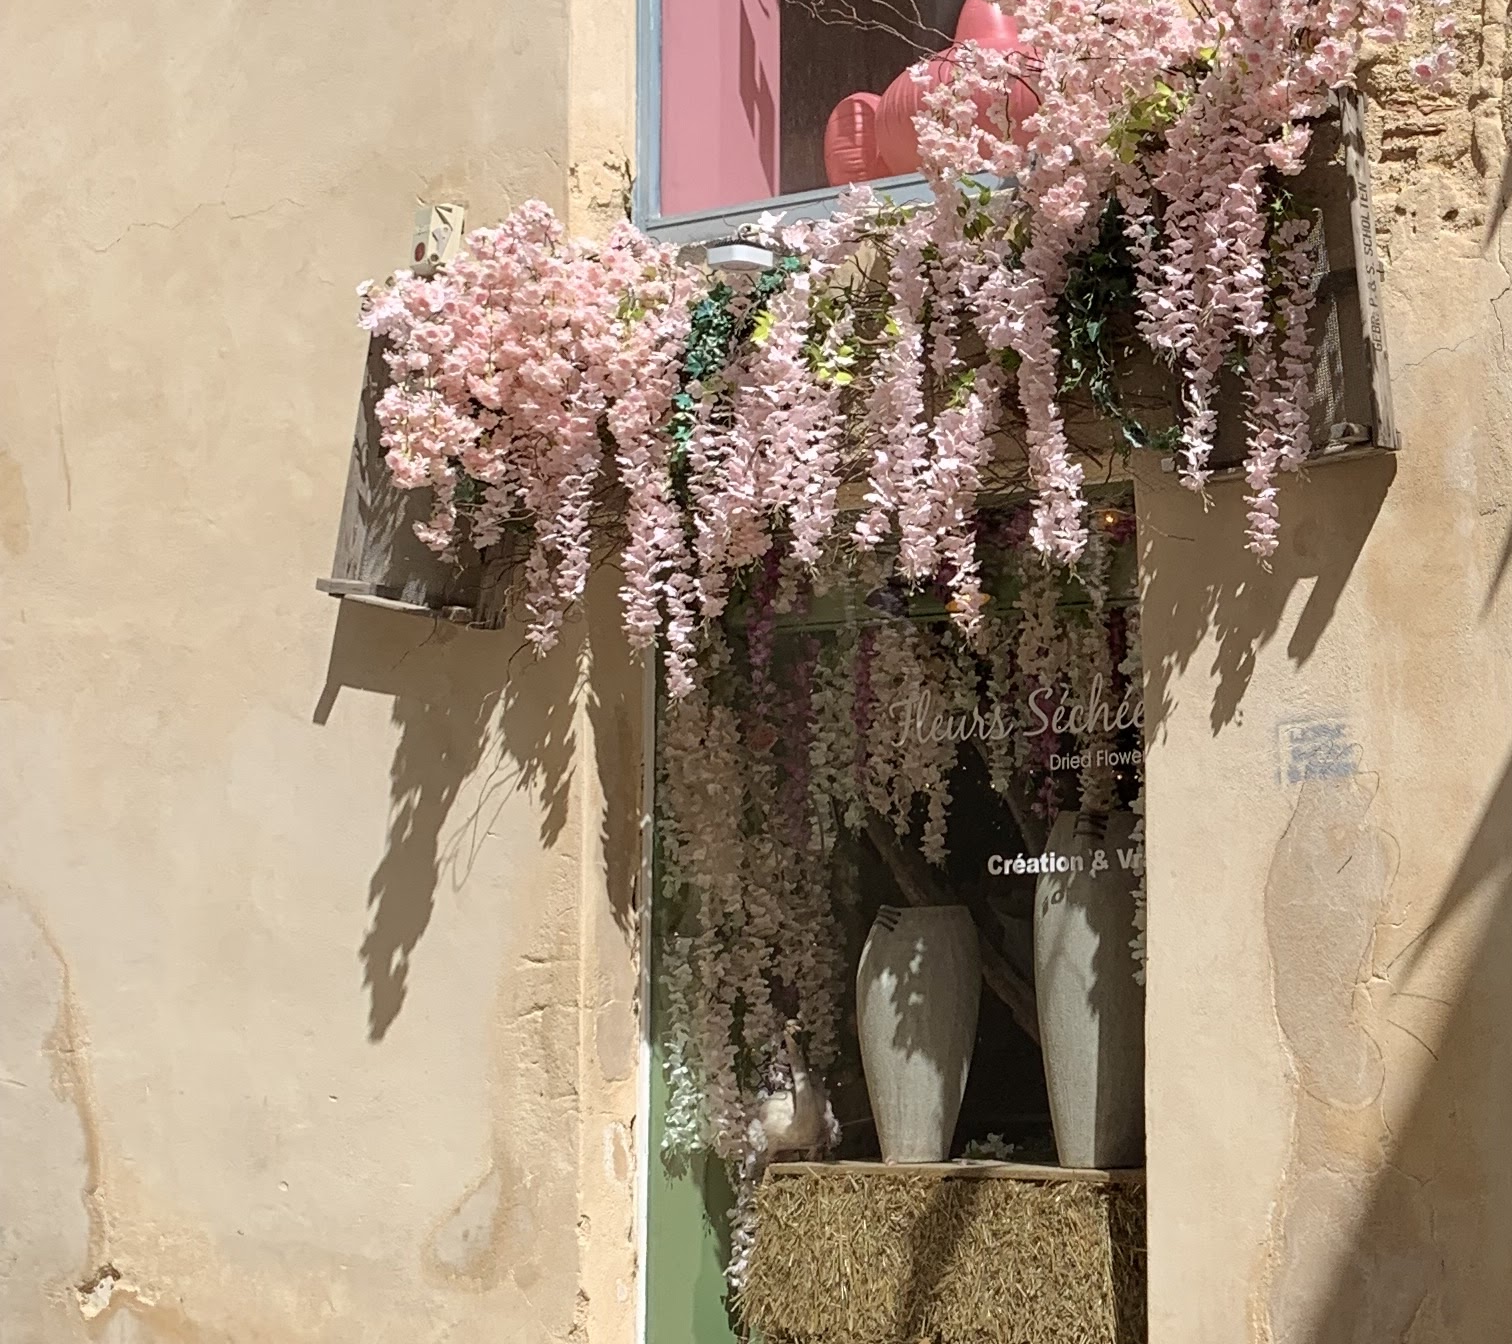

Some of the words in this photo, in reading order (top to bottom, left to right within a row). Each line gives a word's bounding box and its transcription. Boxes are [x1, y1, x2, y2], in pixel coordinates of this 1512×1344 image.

[1357, 181, 1374, 258] SCHOLTEN
[889, 690, 1012, 748] Fleurs
[1023, 672, 1146, 739] Séchée
[1050, 752, 1092, 771] Dried
[1096, 748, 1145, 768] Flowe
[987, 850, 1084, 877] Création
[1091, 850, 1109, 870] &
